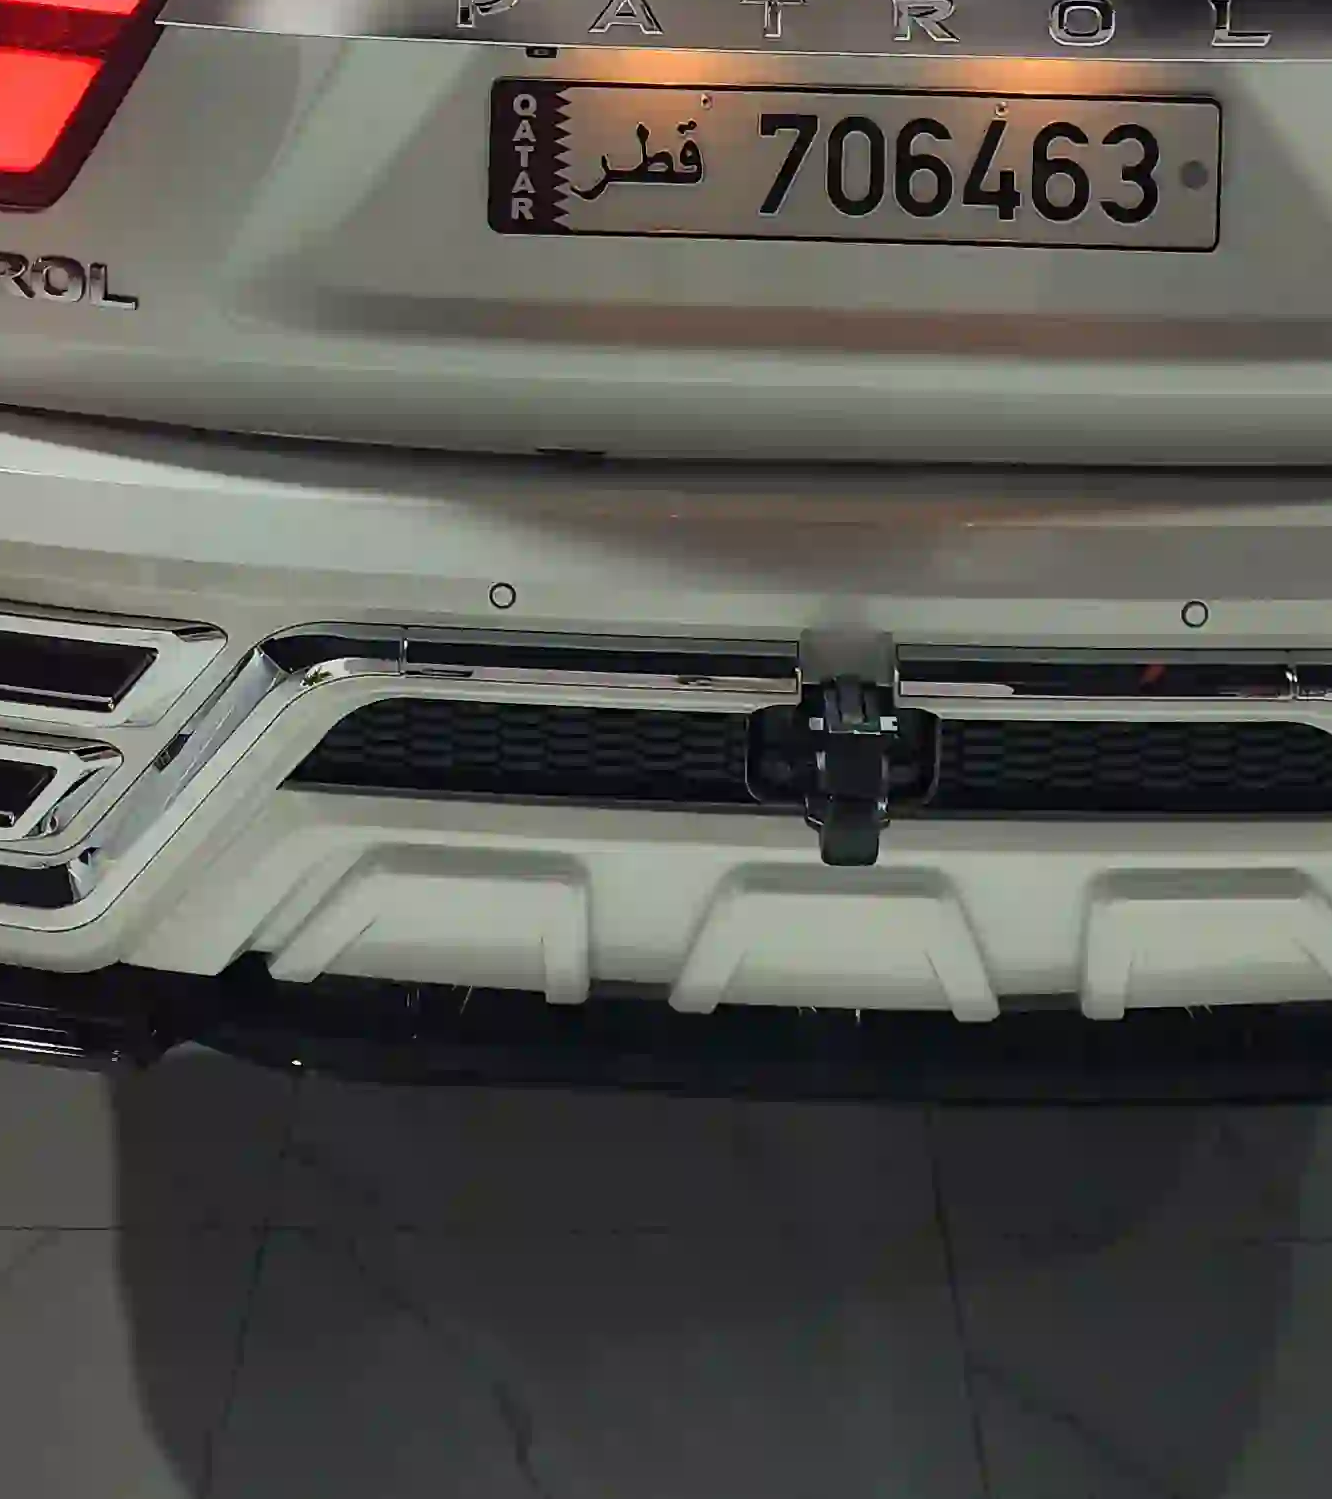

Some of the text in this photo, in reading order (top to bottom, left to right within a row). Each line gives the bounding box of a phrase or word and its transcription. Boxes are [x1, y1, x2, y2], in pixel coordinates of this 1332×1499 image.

[511, 94, 538, 223] QATAR
[567, 119, 705, 201] قطر
[757, 112, 1162, 225] 706463
